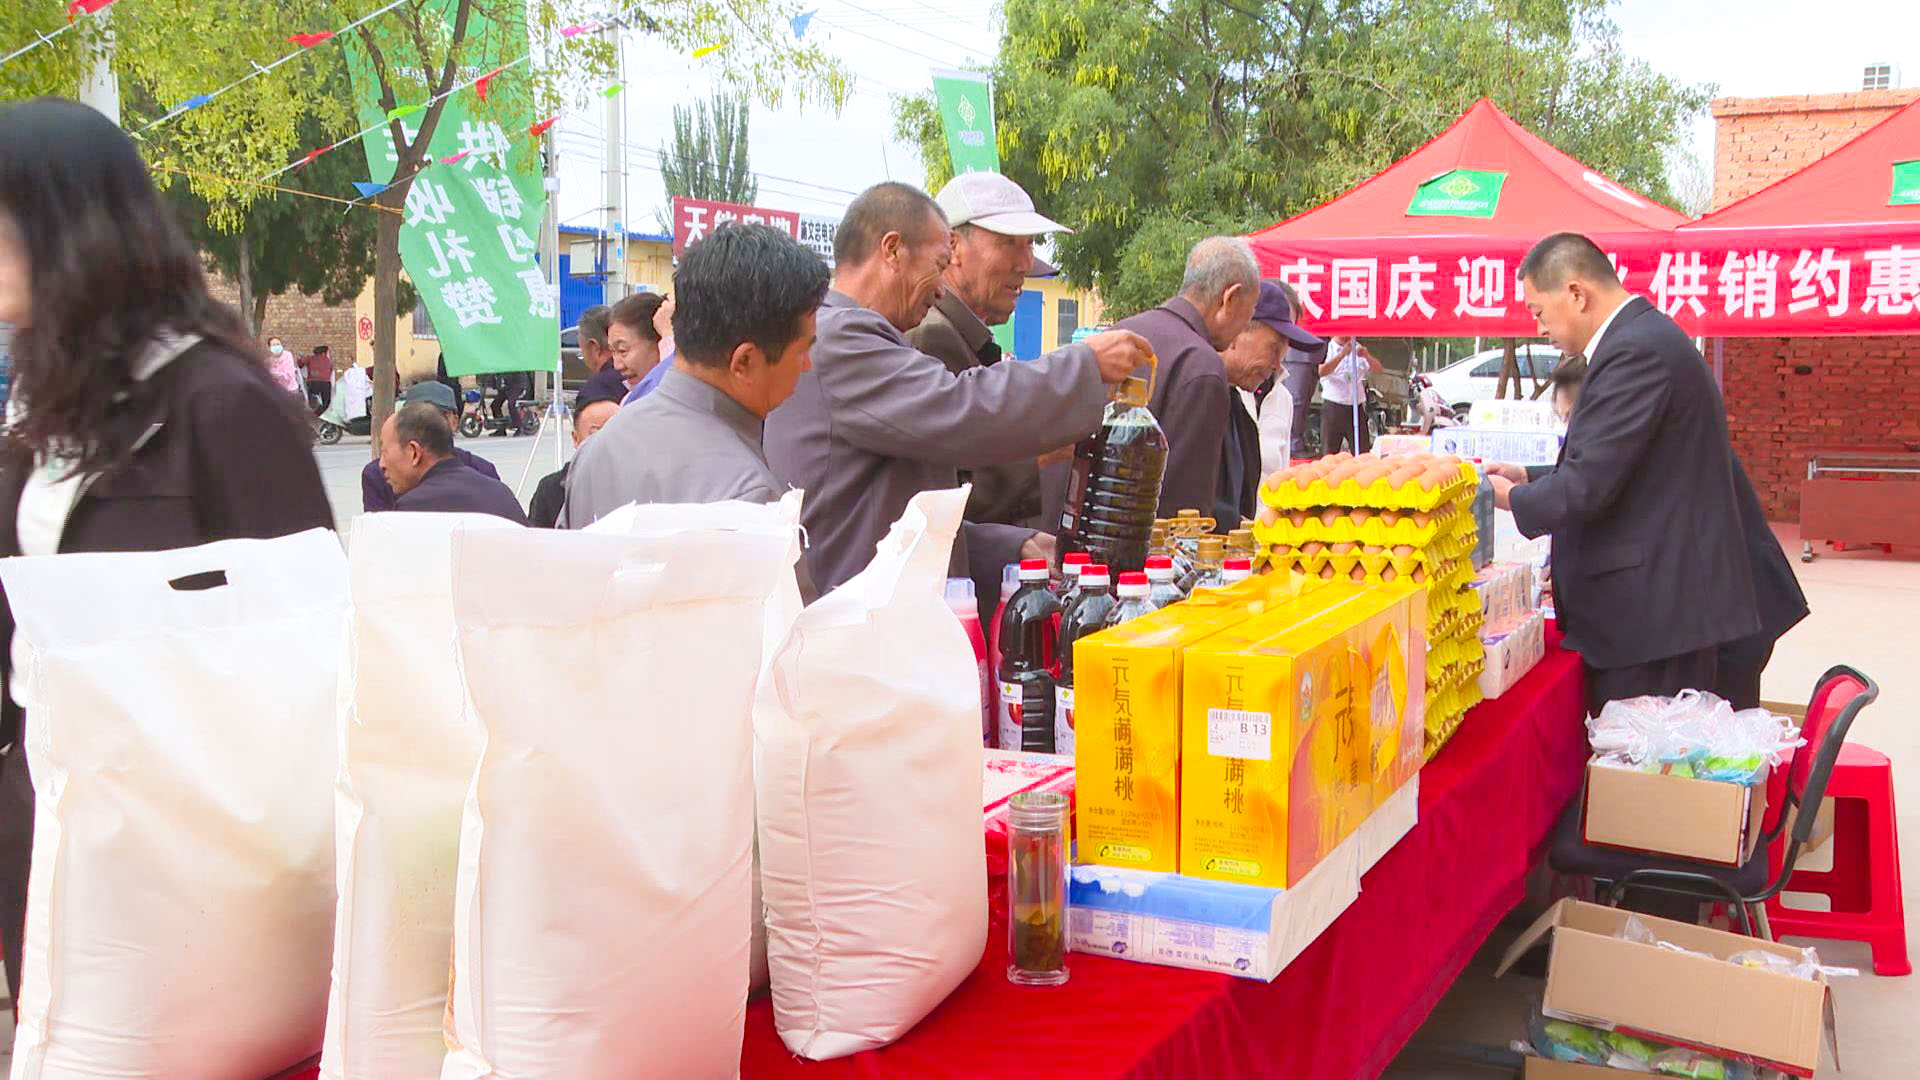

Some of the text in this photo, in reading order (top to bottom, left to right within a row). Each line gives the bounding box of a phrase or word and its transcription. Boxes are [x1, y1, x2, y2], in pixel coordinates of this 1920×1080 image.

[1112, 657, 1134, 802] 元气满满桃
[1223, 665, 1245, 814] 元满桃
[1240, 722, 1267, 736] B 13
